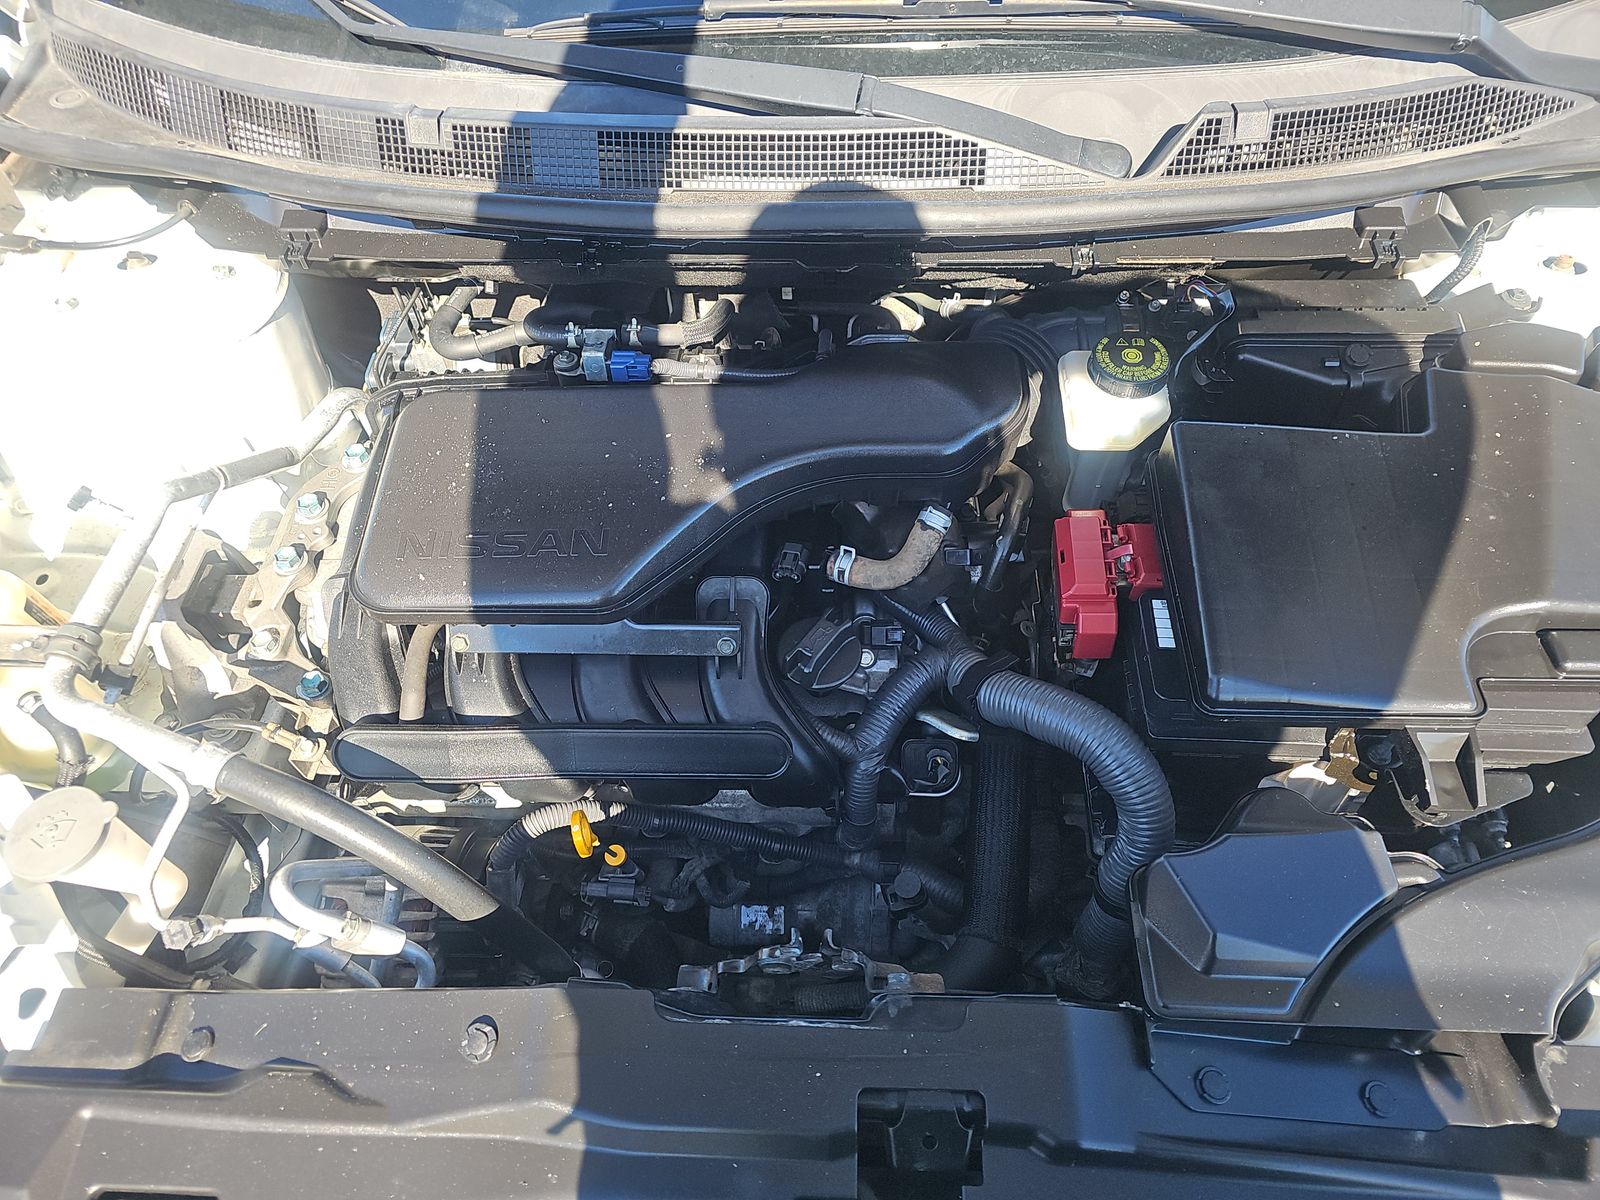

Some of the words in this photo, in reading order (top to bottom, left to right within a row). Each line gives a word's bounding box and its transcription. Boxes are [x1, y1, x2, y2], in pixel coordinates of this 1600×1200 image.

[1107, 363, 1122, 374] FILLER
[1134, 368, 1154, 376] BEFORE
[396, 527, 611, 560] NISSAN
